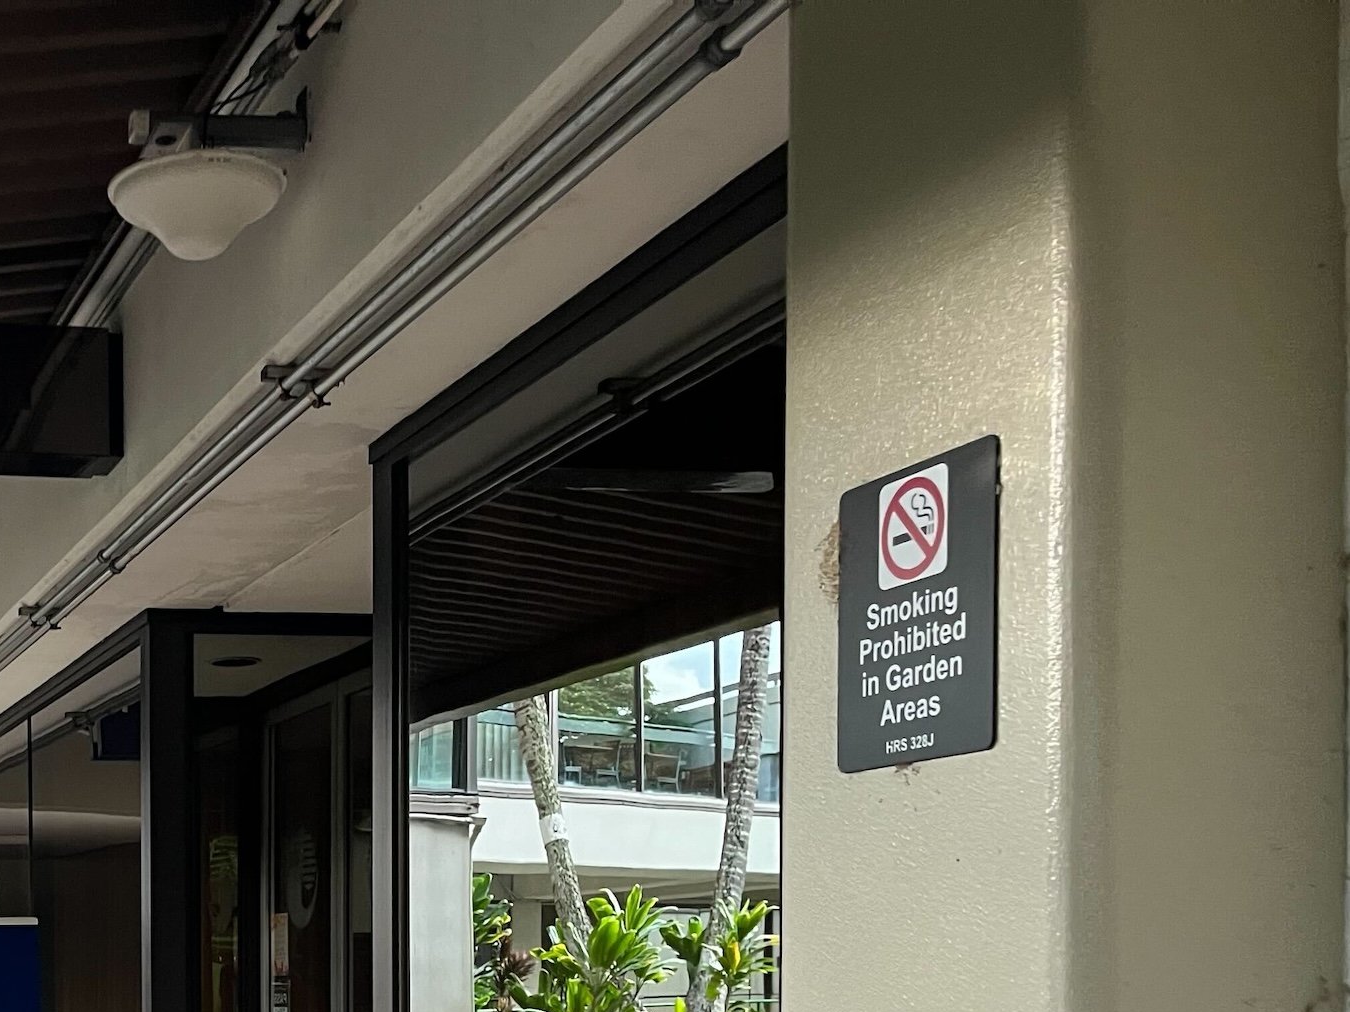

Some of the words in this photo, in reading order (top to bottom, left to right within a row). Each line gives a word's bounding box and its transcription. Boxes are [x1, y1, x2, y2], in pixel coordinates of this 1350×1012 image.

[866, 586, 959, 631] Smoking
[859, 613, 967, 666] Prohibited
[861, 672, 880, 698] in
[885, 653, 963, 693] Garden
[879, 694, 941, 727] Areas
[885, 736, 908, 754] HRS
[910, 732, 934, 750] 328J
